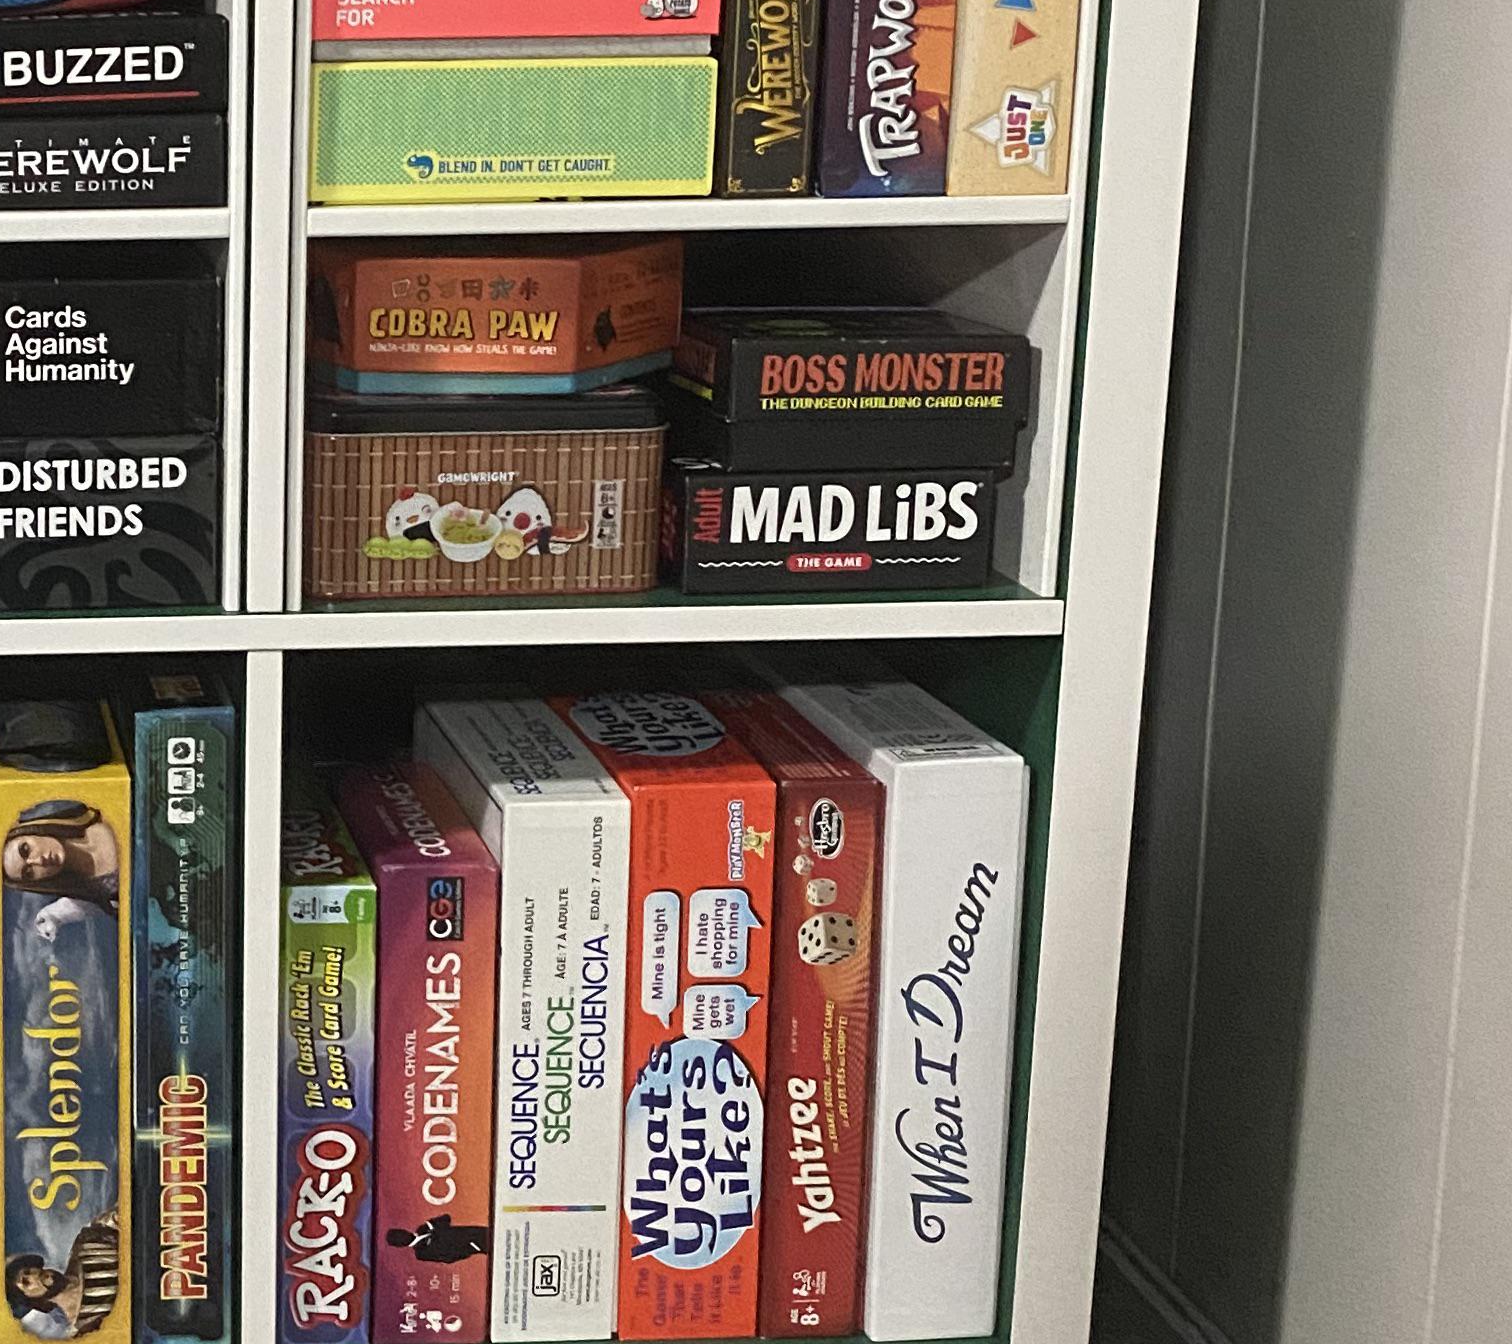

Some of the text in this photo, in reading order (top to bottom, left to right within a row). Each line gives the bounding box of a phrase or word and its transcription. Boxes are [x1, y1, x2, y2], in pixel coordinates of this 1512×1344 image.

[336, 8, 375, 27] FOR
[3, 44, 185, 87] BUZZED
[1004, 94, 1032, 159] JUST
[1028, 109, 1049, 146] ONE
[75, 178, 155, 192] EDITION
[438, 158, 612, 174] BLEND IN. DON'T GET CAUGHT.
[5, 305, 87, 329] Cards
[369, 308, 560, 342] COBRA PAW
[5, 332, 108, 360] Against
[5, 359, 135, 385] Humanity
[759, 354, 848, 396] BOSS
[854, 352, 1006, 394] MONSTER
[760, 396, 1003, 411] THE DUNGEON BUILDING CARD GAME
[693, 487, 724, 545] Adult
[729, 484, 856, 544] MAD
[796, 557, 863, 568] THE GAME
[523, 897, 535, 937] ADULT
[712, 897, 728, 970] shopping
[725, 901, 740, 966] for mine
[522, 939, 533, 988] THROUGH
[651, 907, 669, 1000] Mine is tight
[318, 946, 354, 1111] & Score Card Game!
[521, 1002, 532, 1031] AGES
[578, 933, 609, 1090] SECUENCIA
[692, 993, 706, 1031] Mine
[710, 995, 722, 1029] gets
[724, 997, 736, 1026] wet
[421, 950, 462, 1207] CODENAMES
[543, 997, 575, 1145] SÉQUENCE
[895, 861, 999, 1244] When I Dream
[16, 964, 109, 1211] Splendor
[510, 1042, 540, 1190] SEQUENCE
[711, 1043, 754, 1231] Like?
[631, 1040, 672, 1258] What's
[674, 1054, 718, 1256] yours
[787, 1076, 842, 1234] Yahtzee
[159, 1074, 208, 1301] PANDEMIC
[289, 1129, 357, 1322] RACK-O
[535, 1264, 557, 1293] jax
